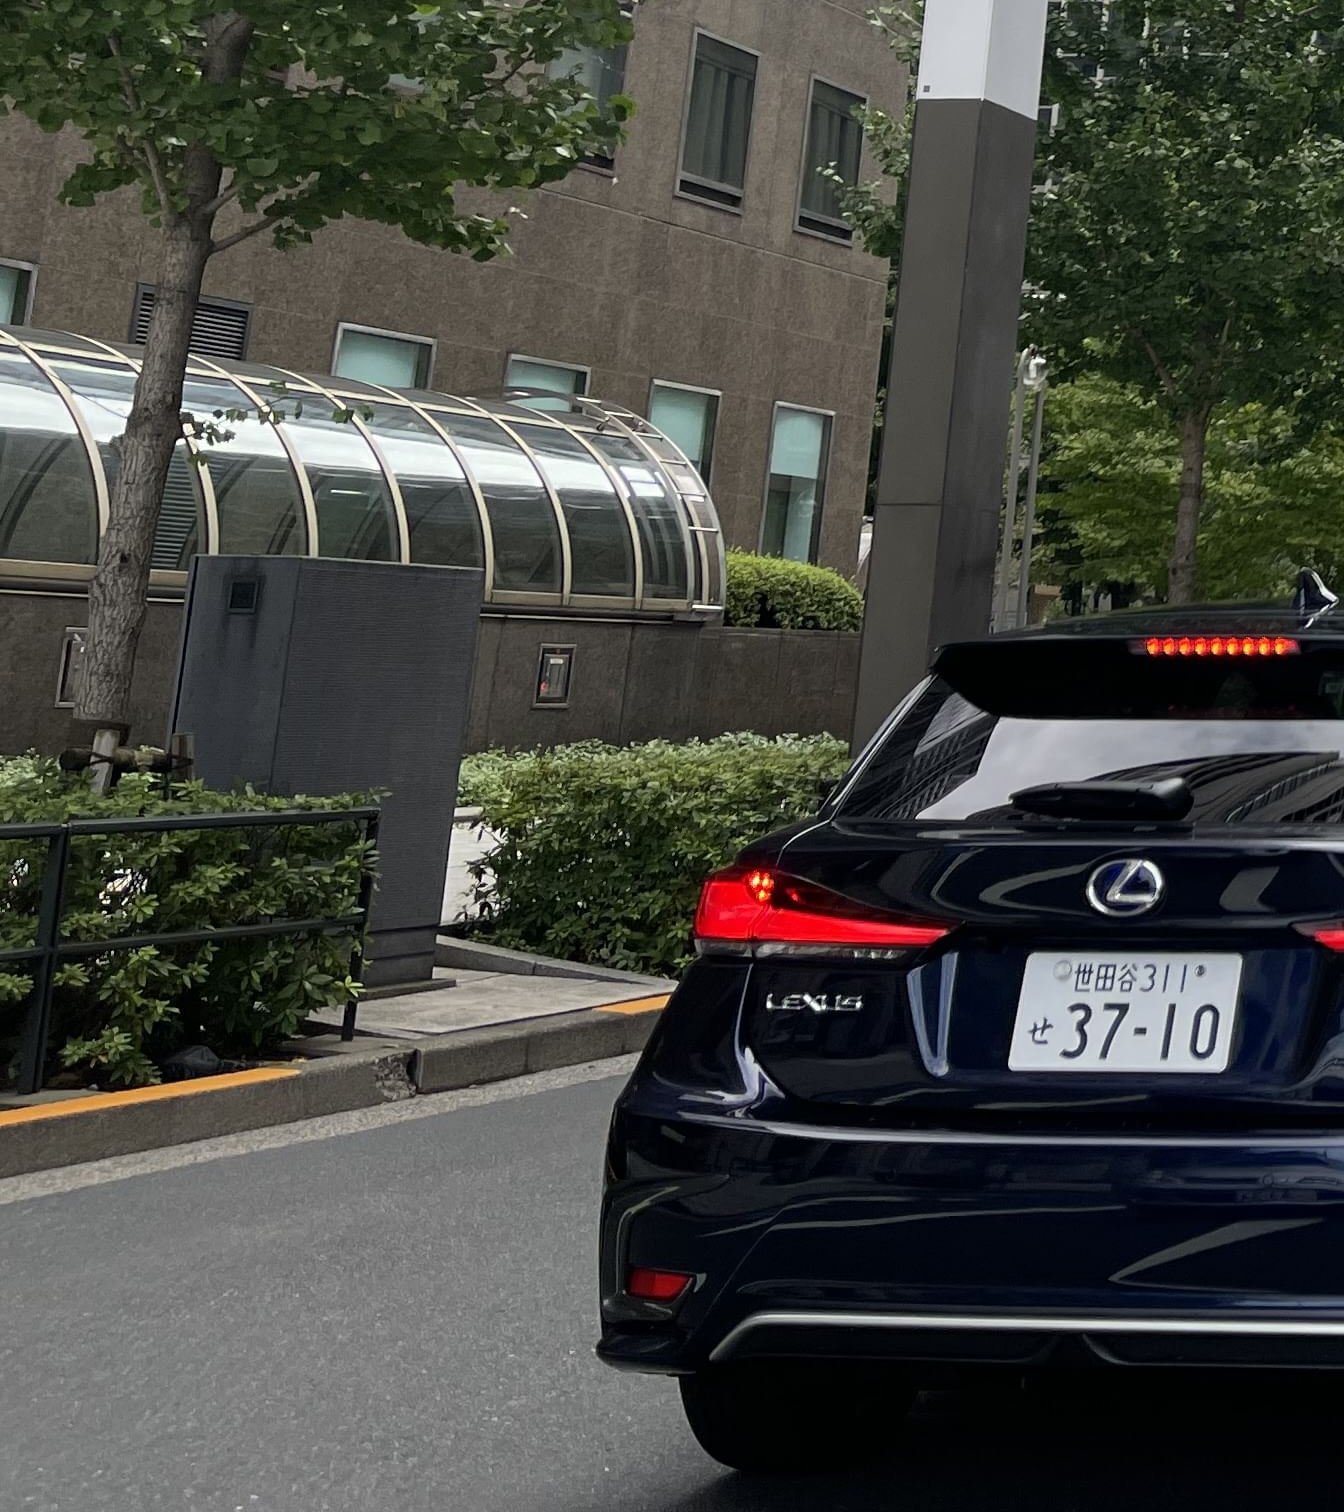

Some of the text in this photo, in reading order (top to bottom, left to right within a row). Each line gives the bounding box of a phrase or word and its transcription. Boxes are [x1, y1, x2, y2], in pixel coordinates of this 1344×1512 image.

[766, 993, 863, 1011] LEXUS
[1028, 1016, 1054, 1045] せ
[1059, 1002, 1221, 1061] 37-10
